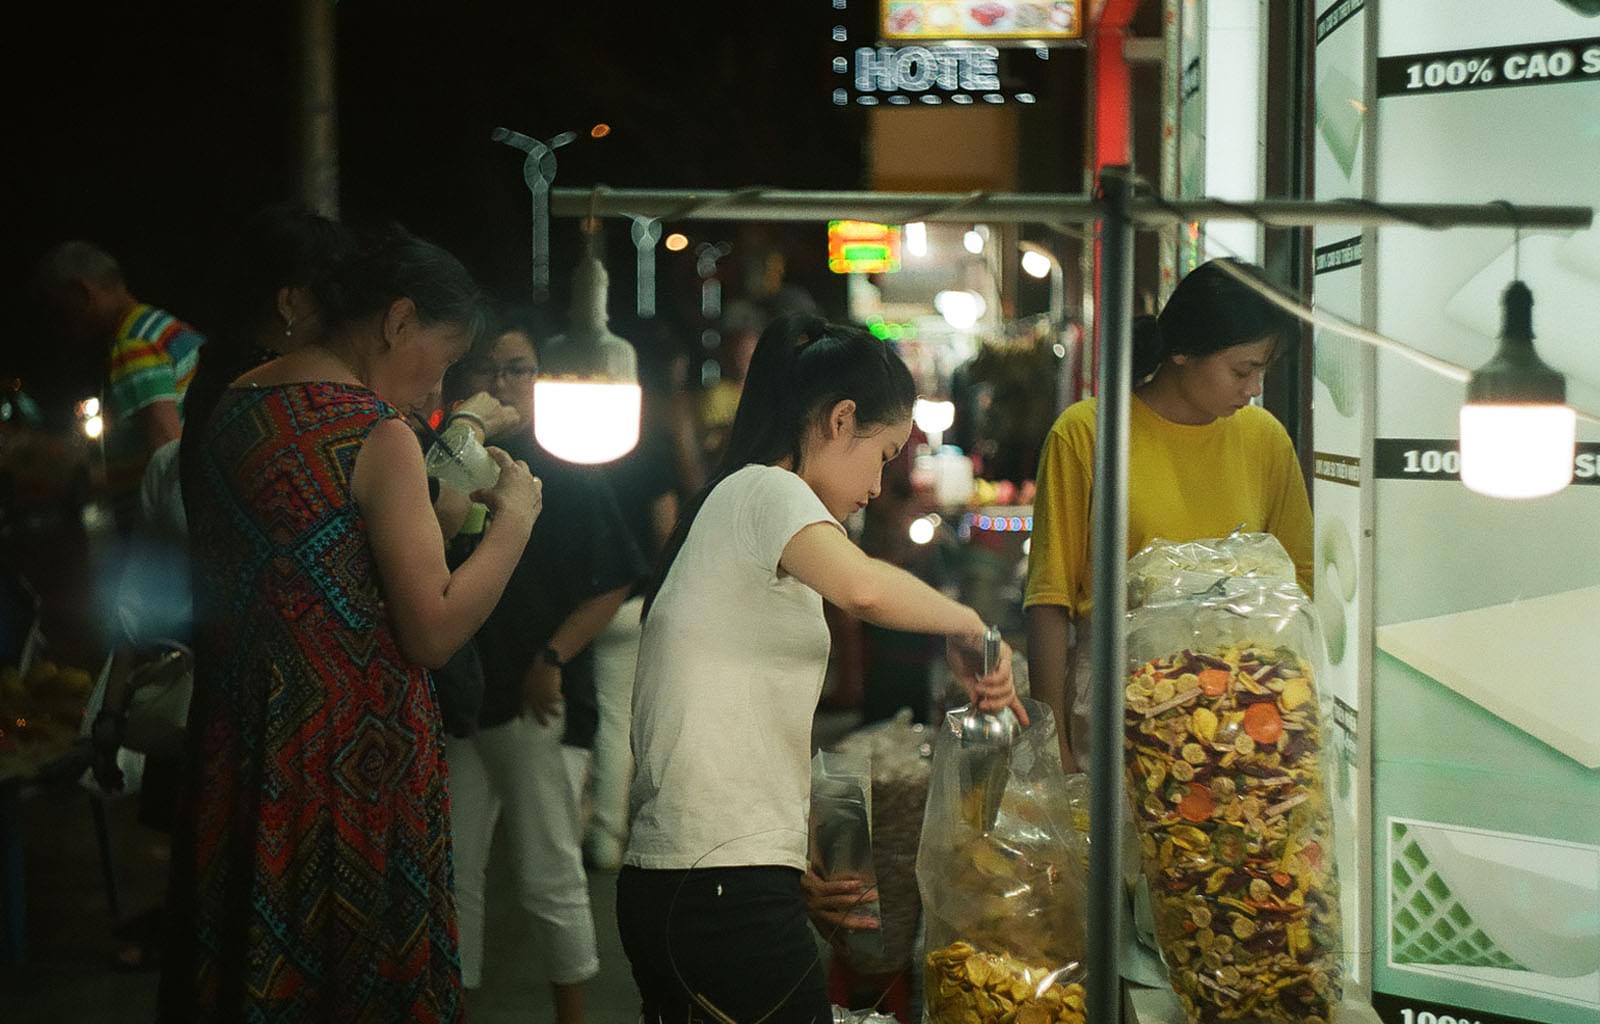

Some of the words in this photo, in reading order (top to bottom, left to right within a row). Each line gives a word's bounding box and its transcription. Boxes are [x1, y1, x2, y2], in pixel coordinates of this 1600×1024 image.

[1406, 58, 1494, 89] 100%
[1503, 51, 1573, 80] CAO
[1403, 450, 1461, 473] 100
[1575, 453, 1600, 478] S
